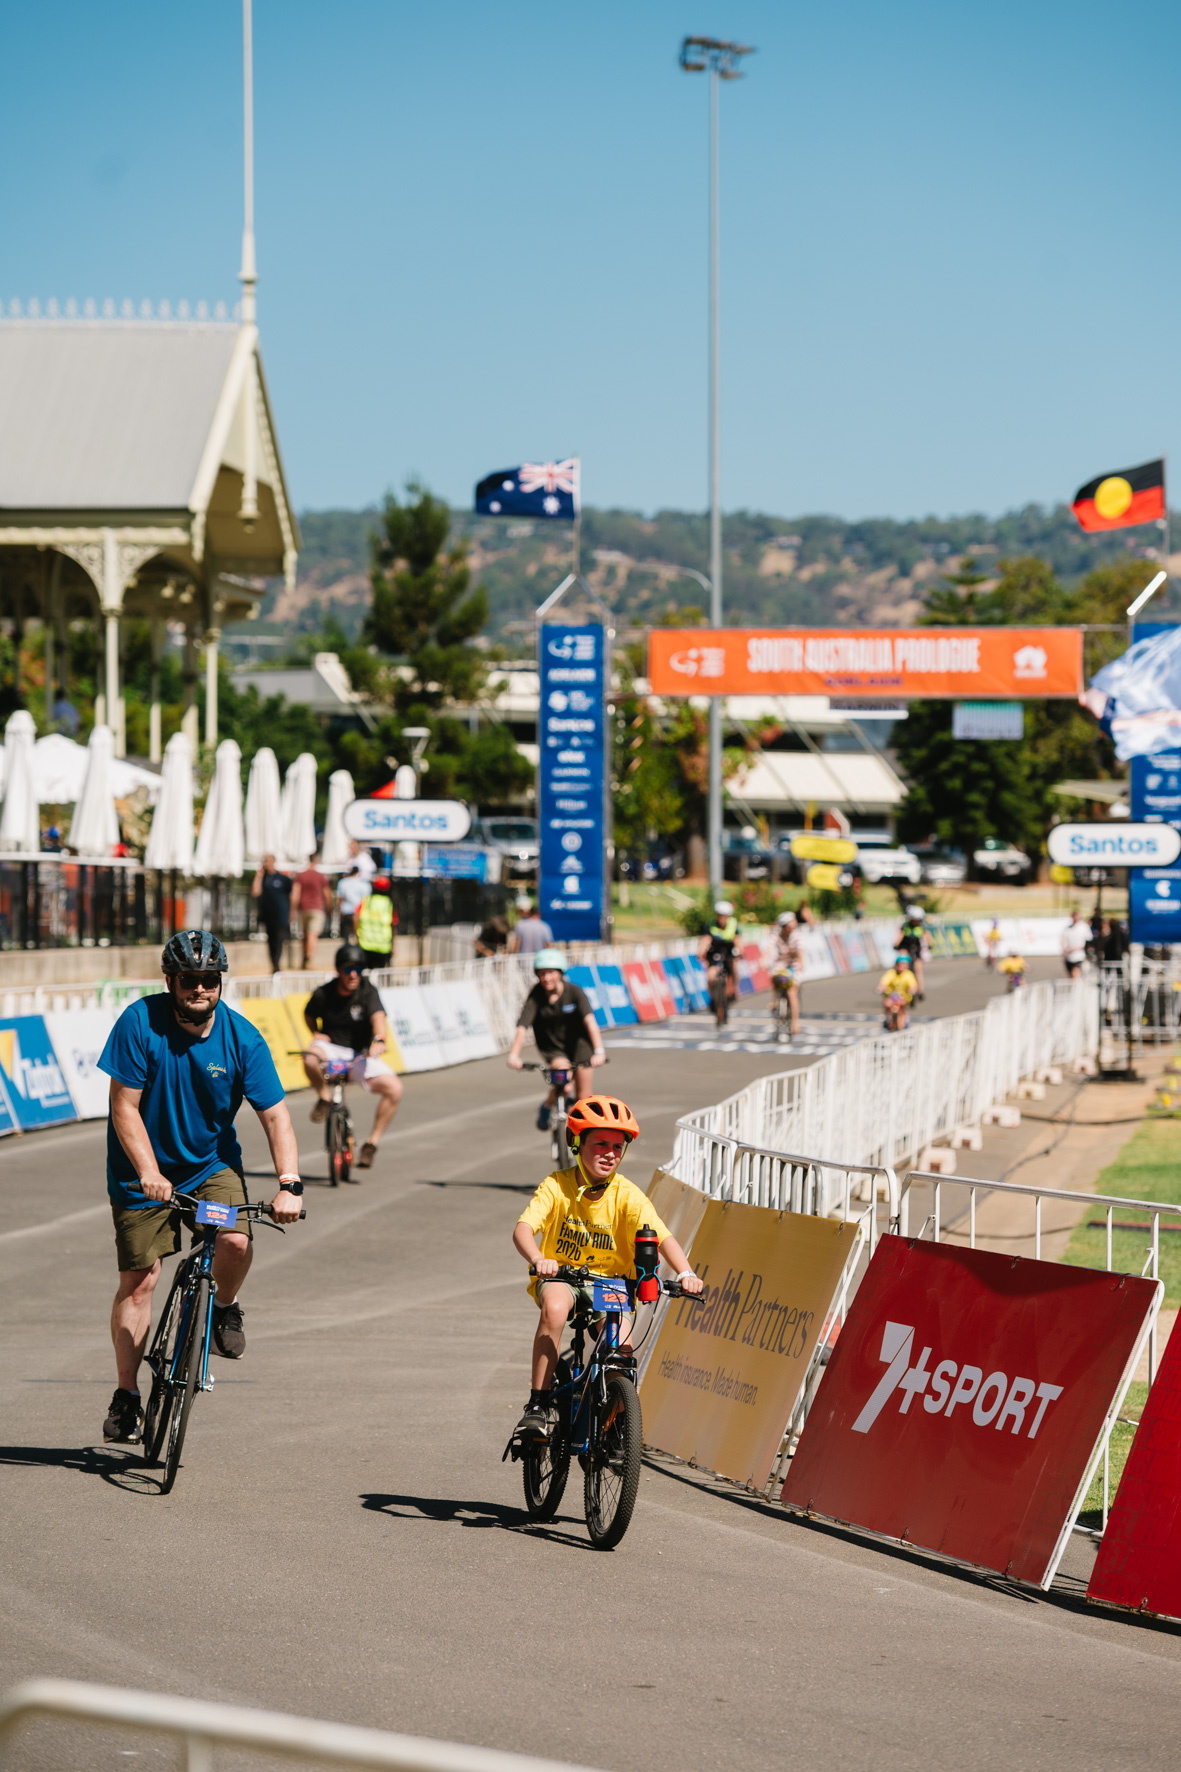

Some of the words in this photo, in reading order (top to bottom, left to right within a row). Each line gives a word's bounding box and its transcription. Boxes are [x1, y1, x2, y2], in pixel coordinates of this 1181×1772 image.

[747, 637, 804, 674] SOUTH
[805, 637, 892, 674] AUSTRALIA
[895, 637, 981, 674] PROLOGUE
[363, 809, 449, 831] Santos
[1069, 833, 1159, 855] Santos
[206, 1211, 228, 1221] 124
[559, 1221, 591, 1247] FAMILY
[591, 1232, 615, 1250] RIDE
[555, 1238, 582, 1261] 2026
[603, 1292, 627, 1303] 123
[729, 1273, 815, 1359] Partners
[657, 1350, 683, 1380] Health
[680, 1355, 712, 1392] insurance.
[709, 1365, 735, 1399] Made
[729, 1371, 759, 1406] human.
